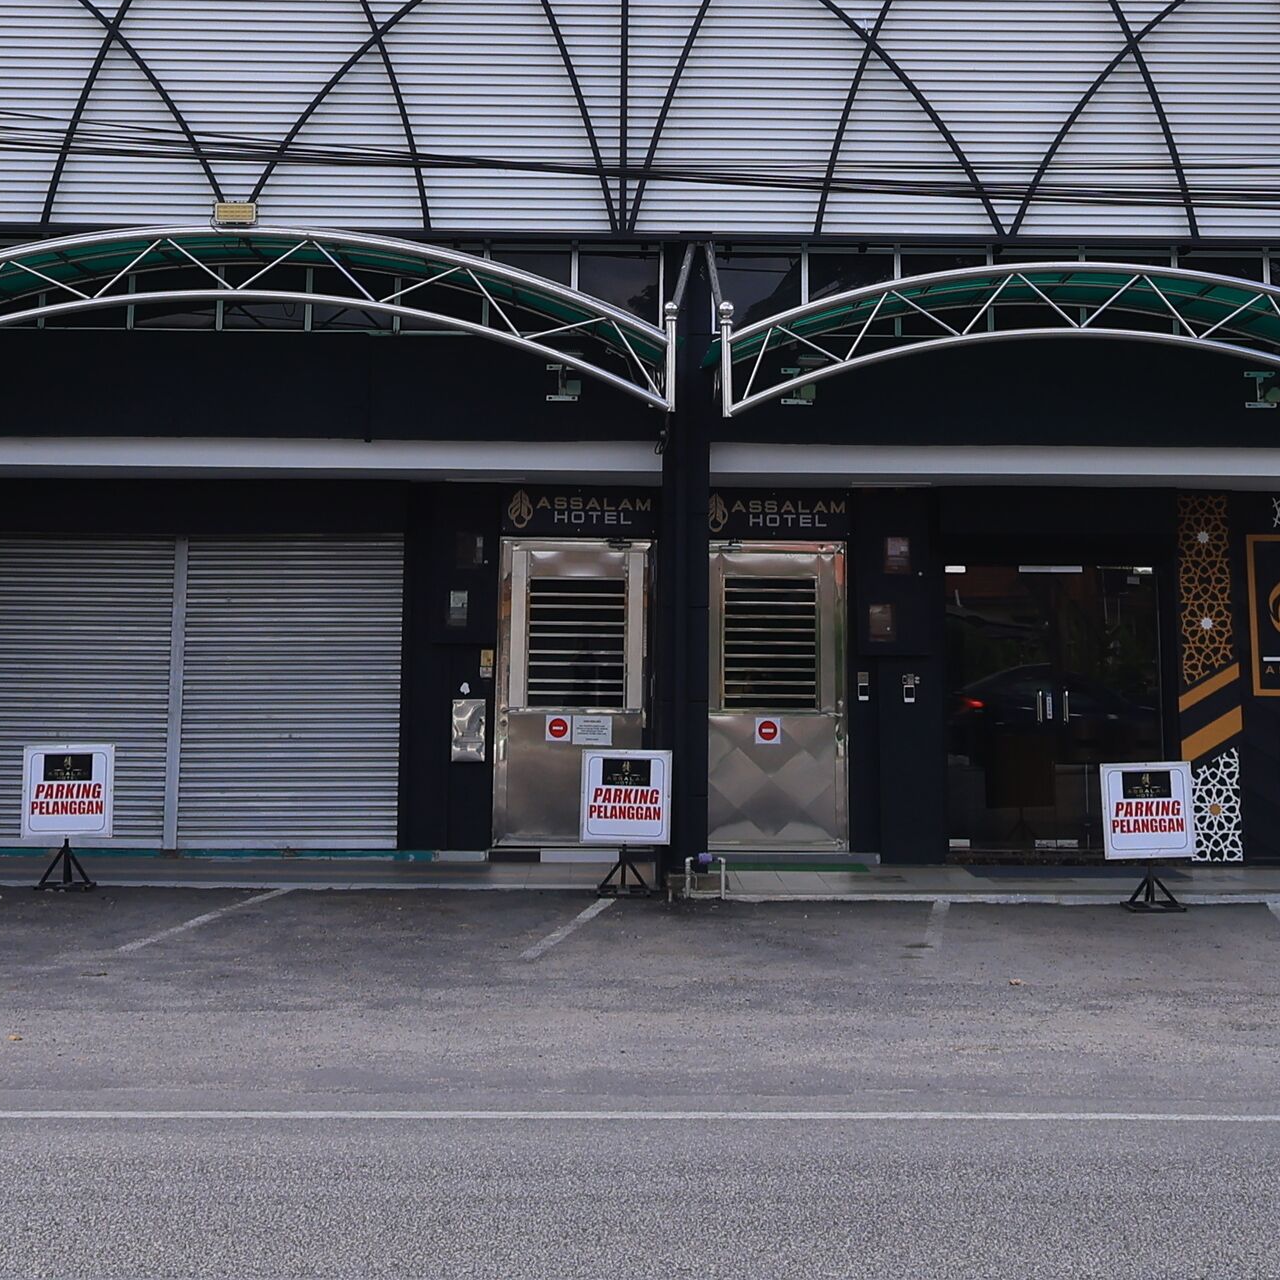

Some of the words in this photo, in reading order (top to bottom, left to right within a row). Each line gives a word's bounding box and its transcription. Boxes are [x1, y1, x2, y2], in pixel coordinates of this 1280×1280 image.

[536, 496, 652, 511] ASSALAM
[731, 500, 846, 513] ASSALAM
[554, 511, 632, 524] HOTEL
[749, 514, 827, 527] HOTEL
[35, 783, 102, 799] PARKING
[593, 787, 660, 804] PARKING
[31, 800, 103, 815] PELANGGAN
[589, 804, 661, 821] PELANGGAN
[1115, 800, 1181, 817] PARKING
[1112, 818, 1184, 834] PELANGGAN
